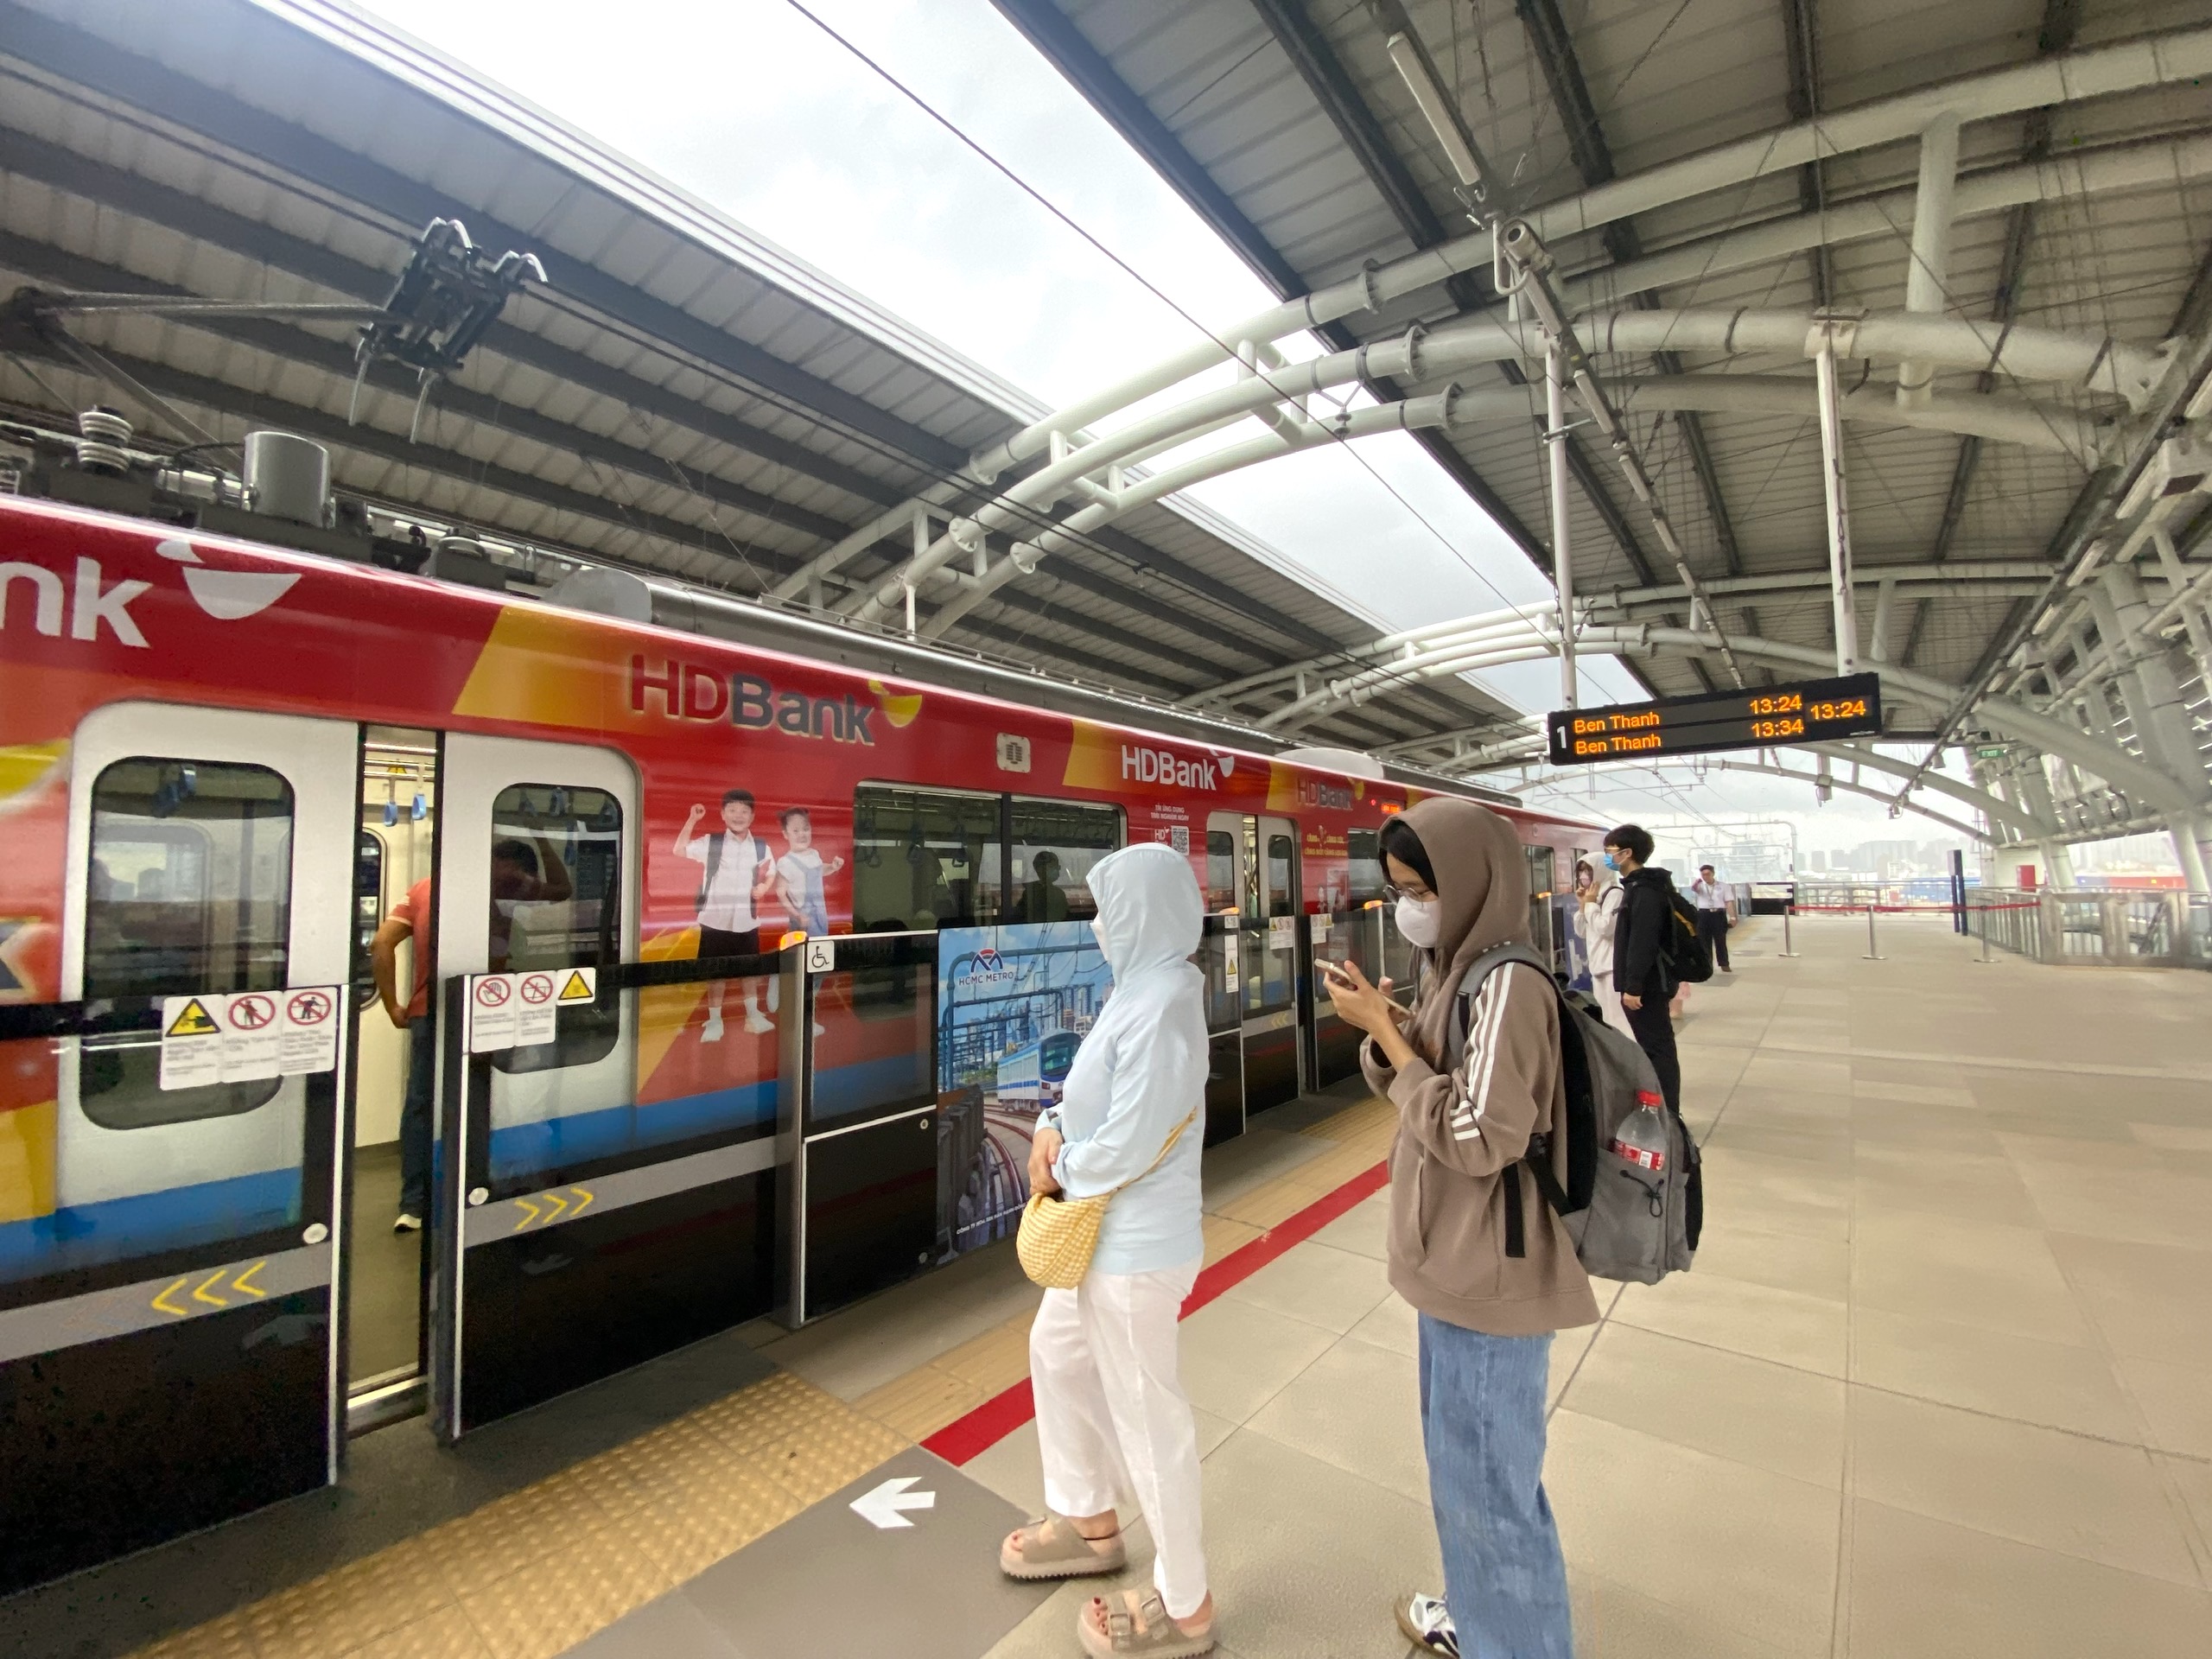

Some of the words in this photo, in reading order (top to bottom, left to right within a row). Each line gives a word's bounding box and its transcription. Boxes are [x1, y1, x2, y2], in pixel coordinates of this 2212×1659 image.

[0, 556, 154, 648] nk
[630, 652, 875, 747] HDBank
[1573, 719, 1605, 734] Ben
[1609, 711, 1660, 729] Thanh
[1750, 694, 1802, 715] 13:24
[1810, 700, 1866, 720] 13:24
[1556, 725, 1567, 749] 1
[1576, 740, 1607, 754] Ben
[1611, 734, 1662, 751] Thanh
[1751, 718, 1804, 738] 13:34
[1122, 744, 1217, 791] HDBank
[1297, 776, 1353, 811] HDBank
[959, 975, 983, 986] HCMC
[986, 971, 1014, 982] METRO
